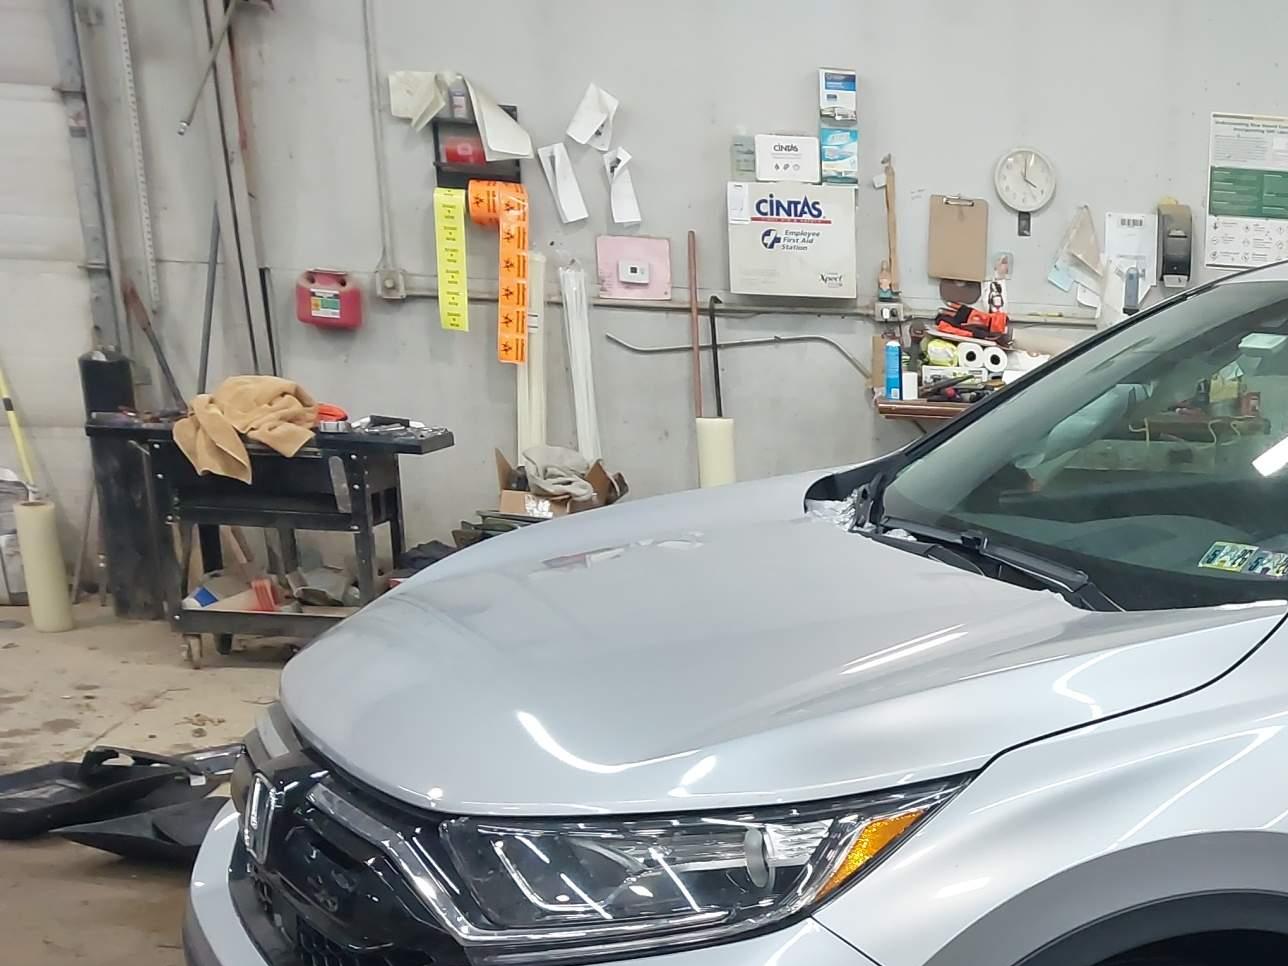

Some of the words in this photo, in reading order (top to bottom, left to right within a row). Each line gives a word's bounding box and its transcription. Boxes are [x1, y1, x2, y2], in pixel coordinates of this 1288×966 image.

[755, 193, 823, 218] CINTAS
[785, 229, 821, 239] Employee
[783, 236, 799, 244] First
[801, 236, 814, 244] Aid
[781, 243, 808, 251] Station
